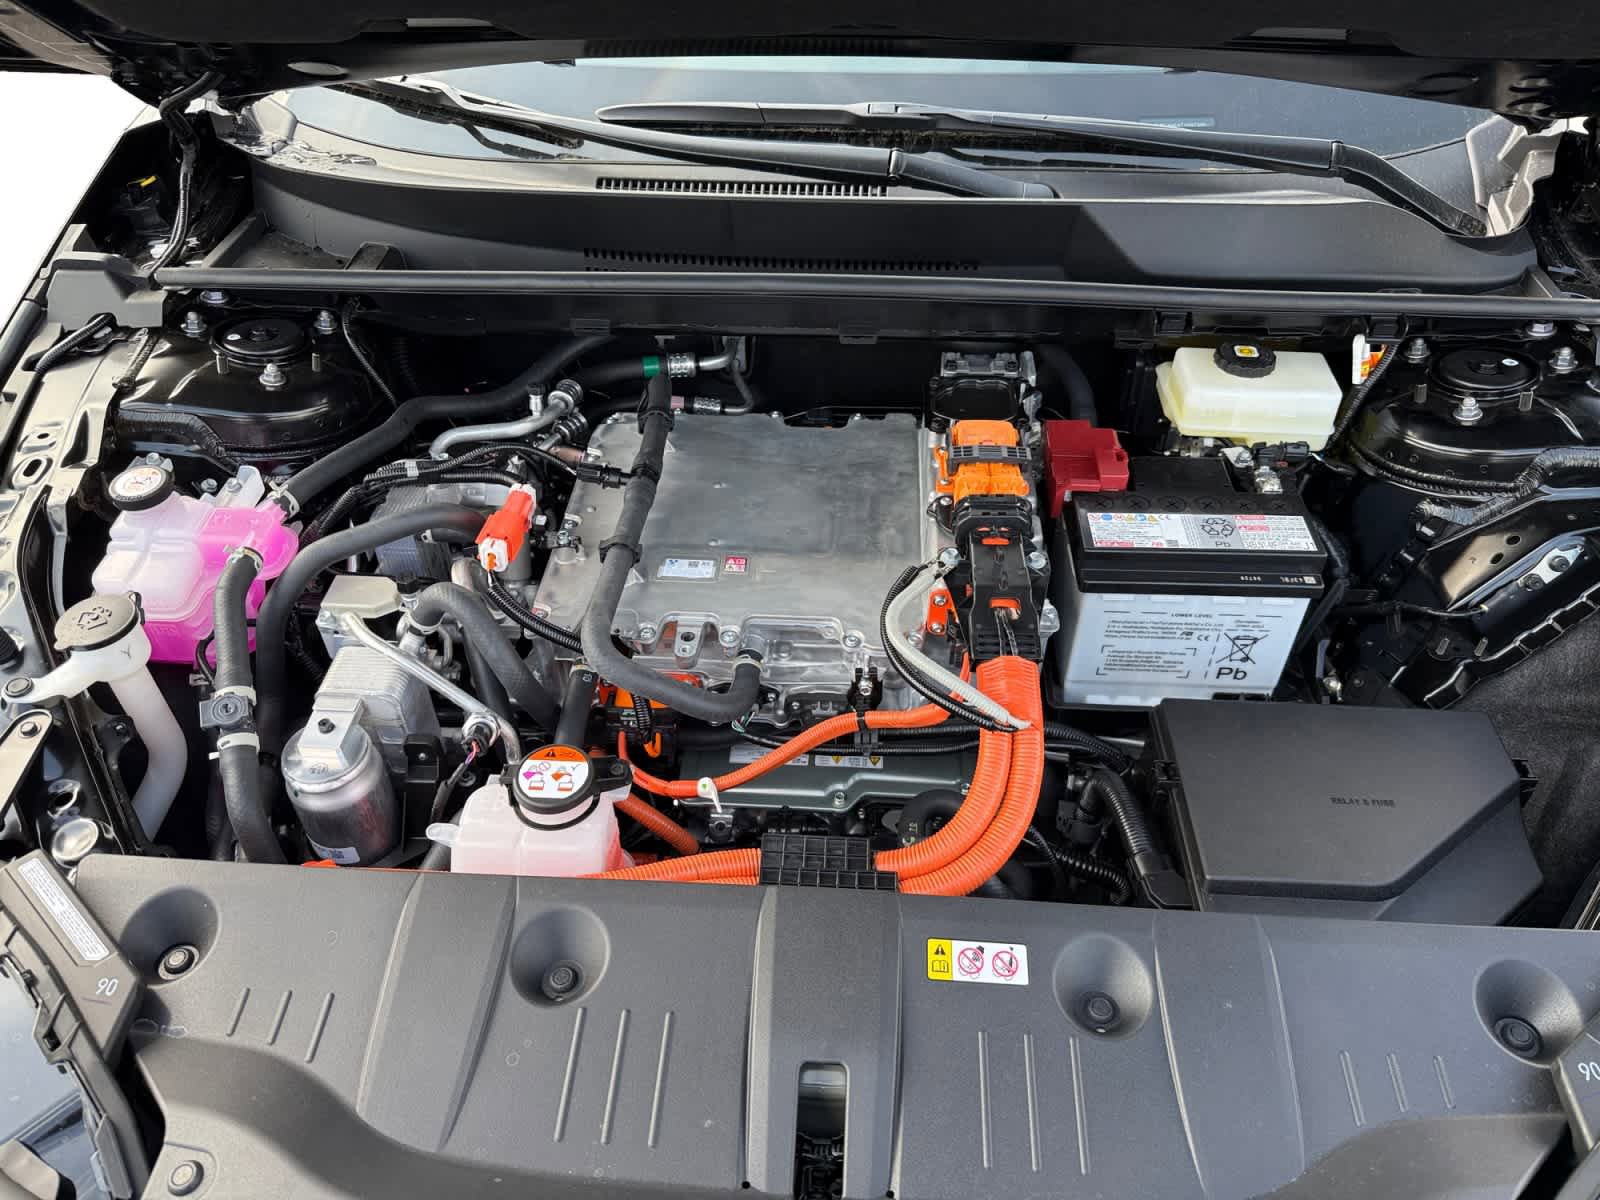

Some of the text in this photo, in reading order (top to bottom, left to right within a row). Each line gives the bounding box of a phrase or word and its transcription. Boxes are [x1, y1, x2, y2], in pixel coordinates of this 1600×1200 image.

[1216, 667, 1247, 681] Pb
[1329, 797, 1360, 806] RELAY
[1371, 799, 1395, 807] FUSE
[95, 978, 118, 996] 90
[1577, 1062, 1600, 1081] 90
